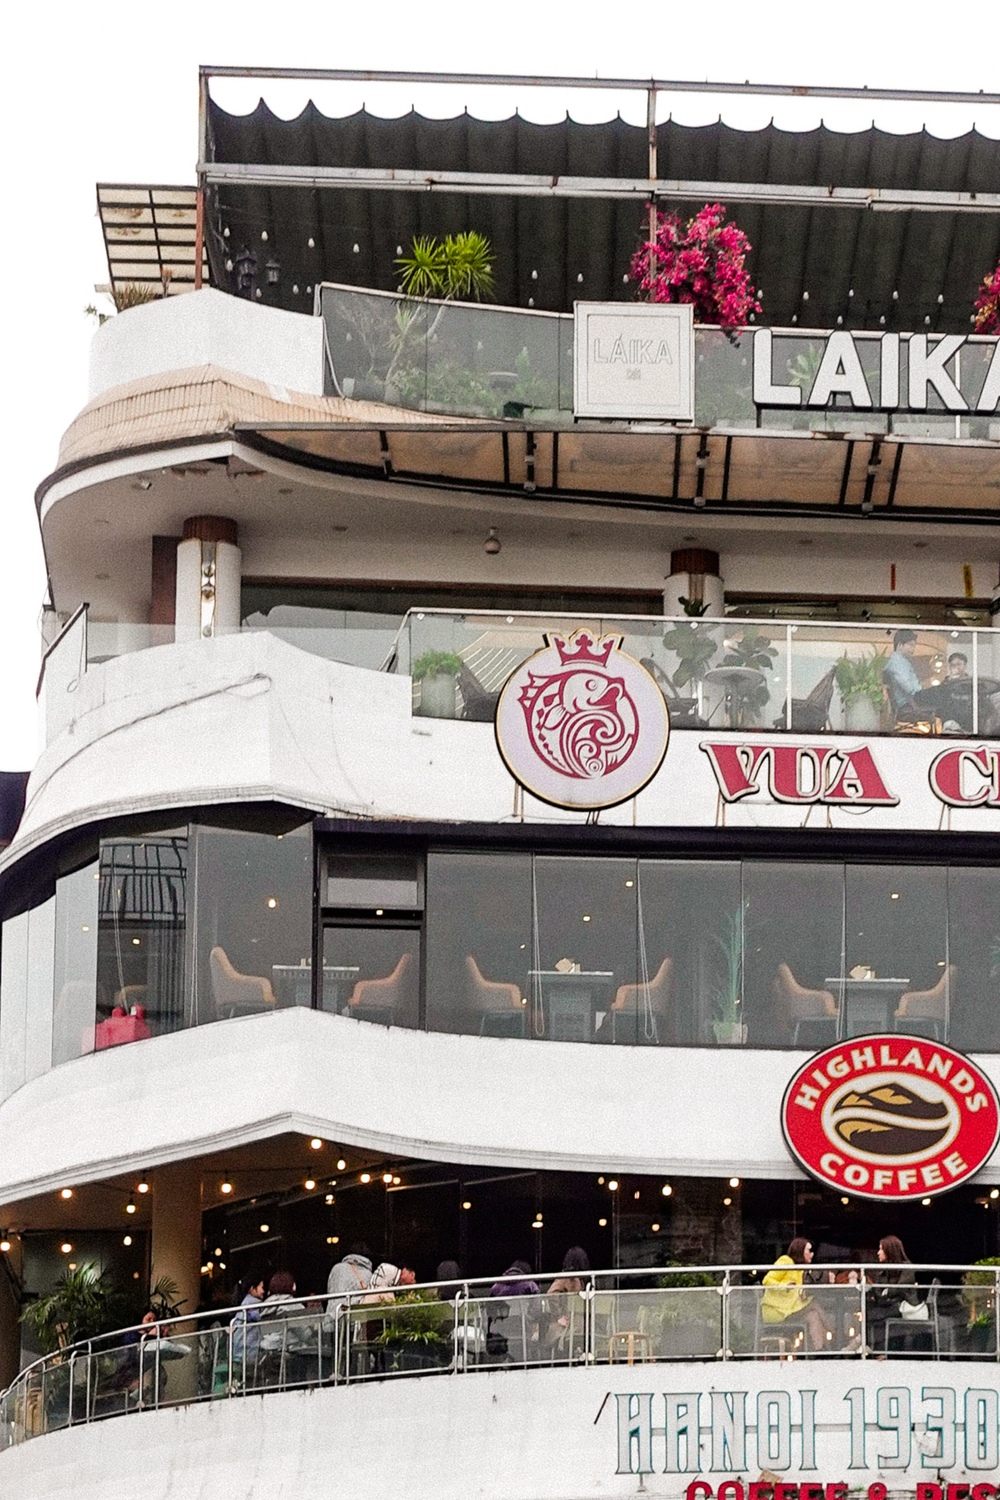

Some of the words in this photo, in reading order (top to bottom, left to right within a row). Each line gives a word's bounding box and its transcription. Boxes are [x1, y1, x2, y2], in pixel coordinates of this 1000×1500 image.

[701, 740, 900, 809] VUA
[794, 1045, 988, 1113] HIGHLANDS
[819, 1151, 968, 1191] COFFEE
[614, 1390, 818, 1475] HANOI
[844, 1386, 1000, 1471] 1930
